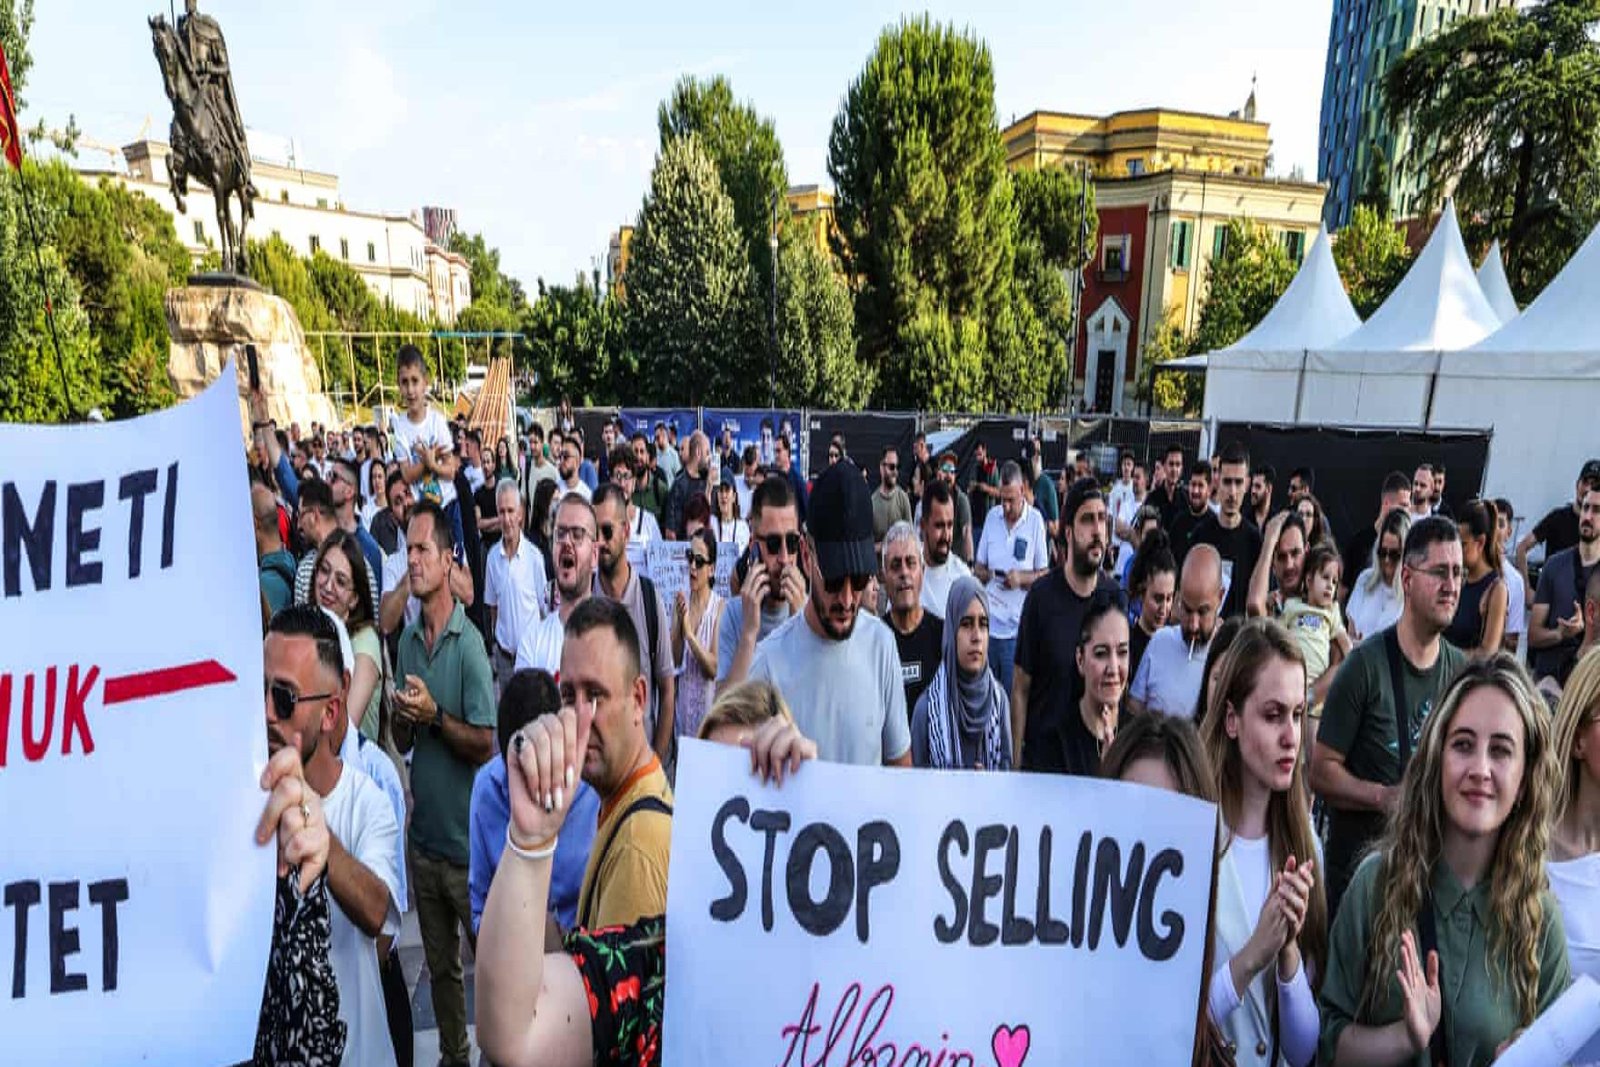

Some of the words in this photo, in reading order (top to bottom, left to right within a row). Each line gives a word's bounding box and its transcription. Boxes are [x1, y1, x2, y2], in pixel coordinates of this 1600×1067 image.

[2, 460, 179, 598] NETI
[4, 876, 130, 999] TET
[709, 795, 901, 944] STOP
[933, 818, 1186, 962] SELLING
